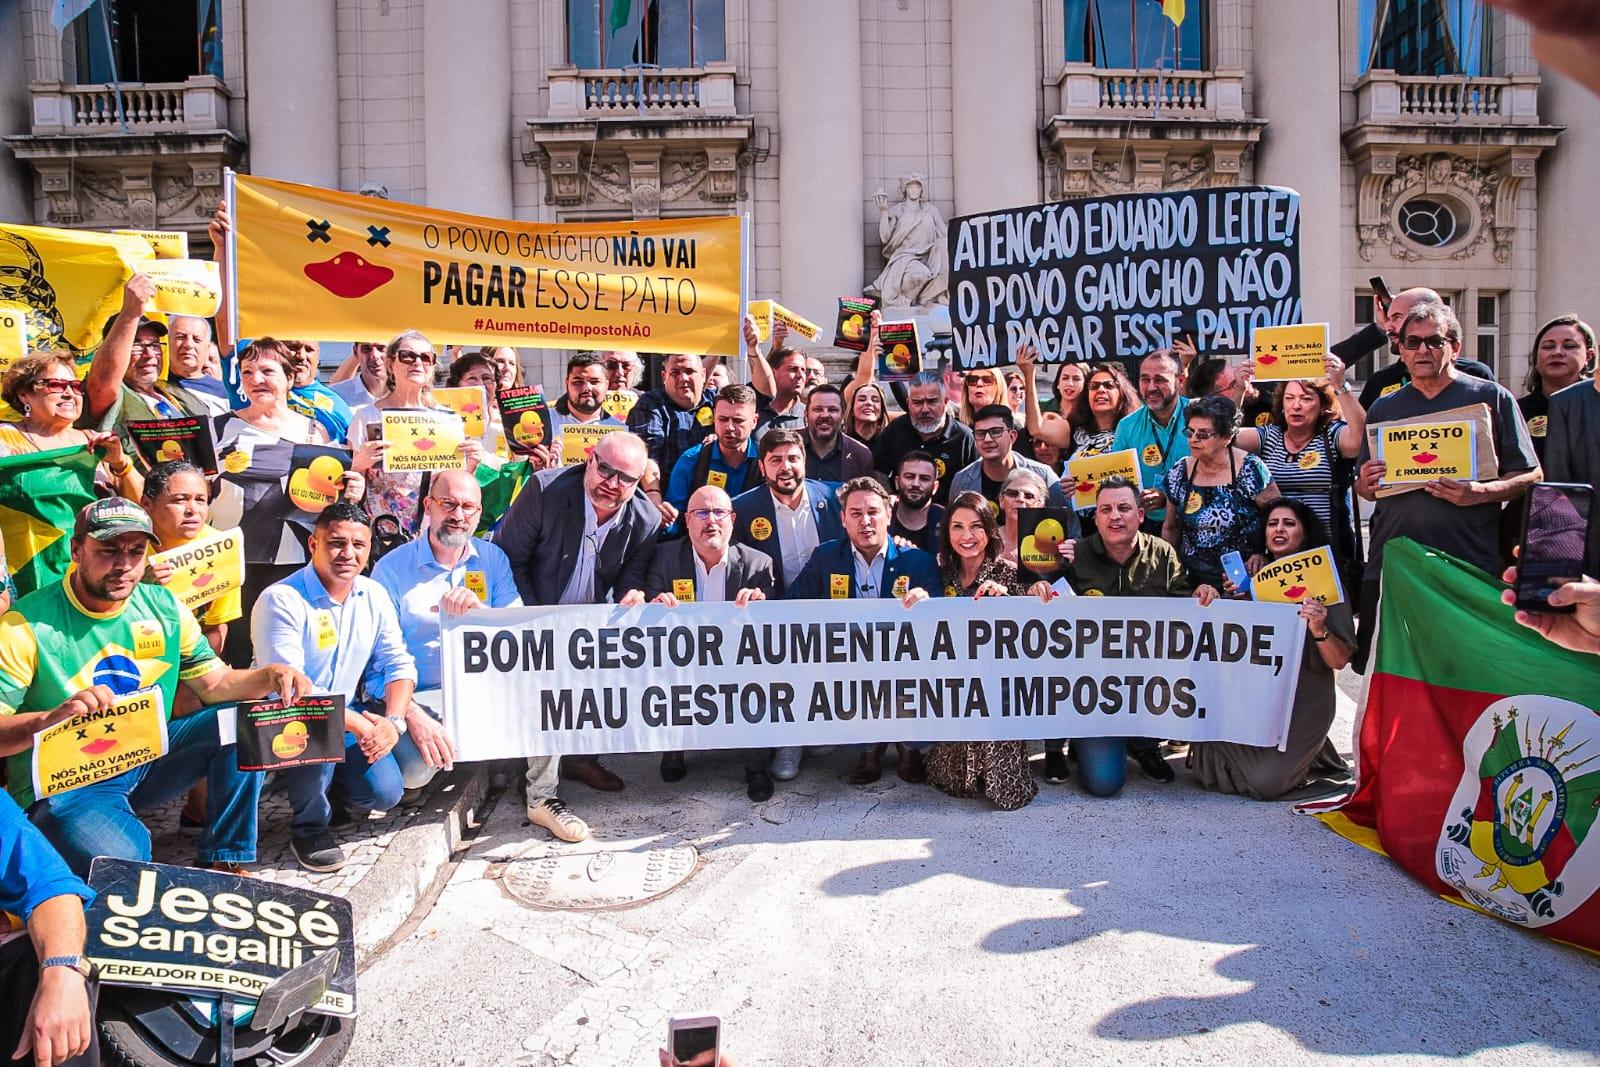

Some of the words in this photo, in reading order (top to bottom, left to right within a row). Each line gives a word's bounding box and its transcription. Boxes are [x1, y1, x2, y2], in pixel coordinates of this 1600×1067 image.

[423, 224, 440, 249] O
[448, 226, 510, 256] POVO
[517, 230, 609, 263] GAÚCHO
[612, 230, 656, 267] NÃO
[662, 237, 697, 269] VAI
[954, 204, 1080, 271] ATENÇÃO
[1084, 195, 1198, 255] EDUARDO
[1208, 191, 1300, 247] LEITE!
[423, 260, 526, 308] PAGAR
[536, 268, 609, 311] ESSE
[621, 275, 697, 315] PATO
[957, 280, 980, 325] O
[986, 267, 1066, 323] POVO
[1075, 256, 1204, 312] GAÚCHO
[1218, 247, 1292, 303] NÃO
[473, 317, 651, 338] #AumentoDeImpostoNÃO
[953, 324, 997, 369] VAI
[1005, 315, 1106, 363] PAGAR
[1114, 311, 1183, 356] ESSE
[1306, 342, 1322, 350] NÃO
[1388, 427, 1463, 442] IMPOSTO
[1257, 555, 1322, 583] IMPOSTO
[463, 629, 555, 673] BOM
[568, 625, 723, 670] GESTOR
[736, 621, 920, 665] AUMENTA
[931, 620, 956, 660] A
[968, 618, 1283, 677] PROSPERIDADE,
[540, 687, 628, 731] MAU
[641, 682, 795, 728] GESTOR
[808, 677, 989, 722] AUMENTA
[1001, 675, 1206, 719] IMPOSTOS.
[47, 773, 91, 793] PAGAR
[93, 764, 123, 779] ESTE
[126, 752, 158, 768] PATO
[51, 767, 77, 782] NÓS
[79, 759, 106, 773] NÃO
[108, 746, 151, 764] VAMOS
[107, 870, 340, 947] Jessé
[100, 916, 302, 969] Sangalli
[98, 963, 197, 981] VEREADOR
[200, 971, 225, 984] DE
